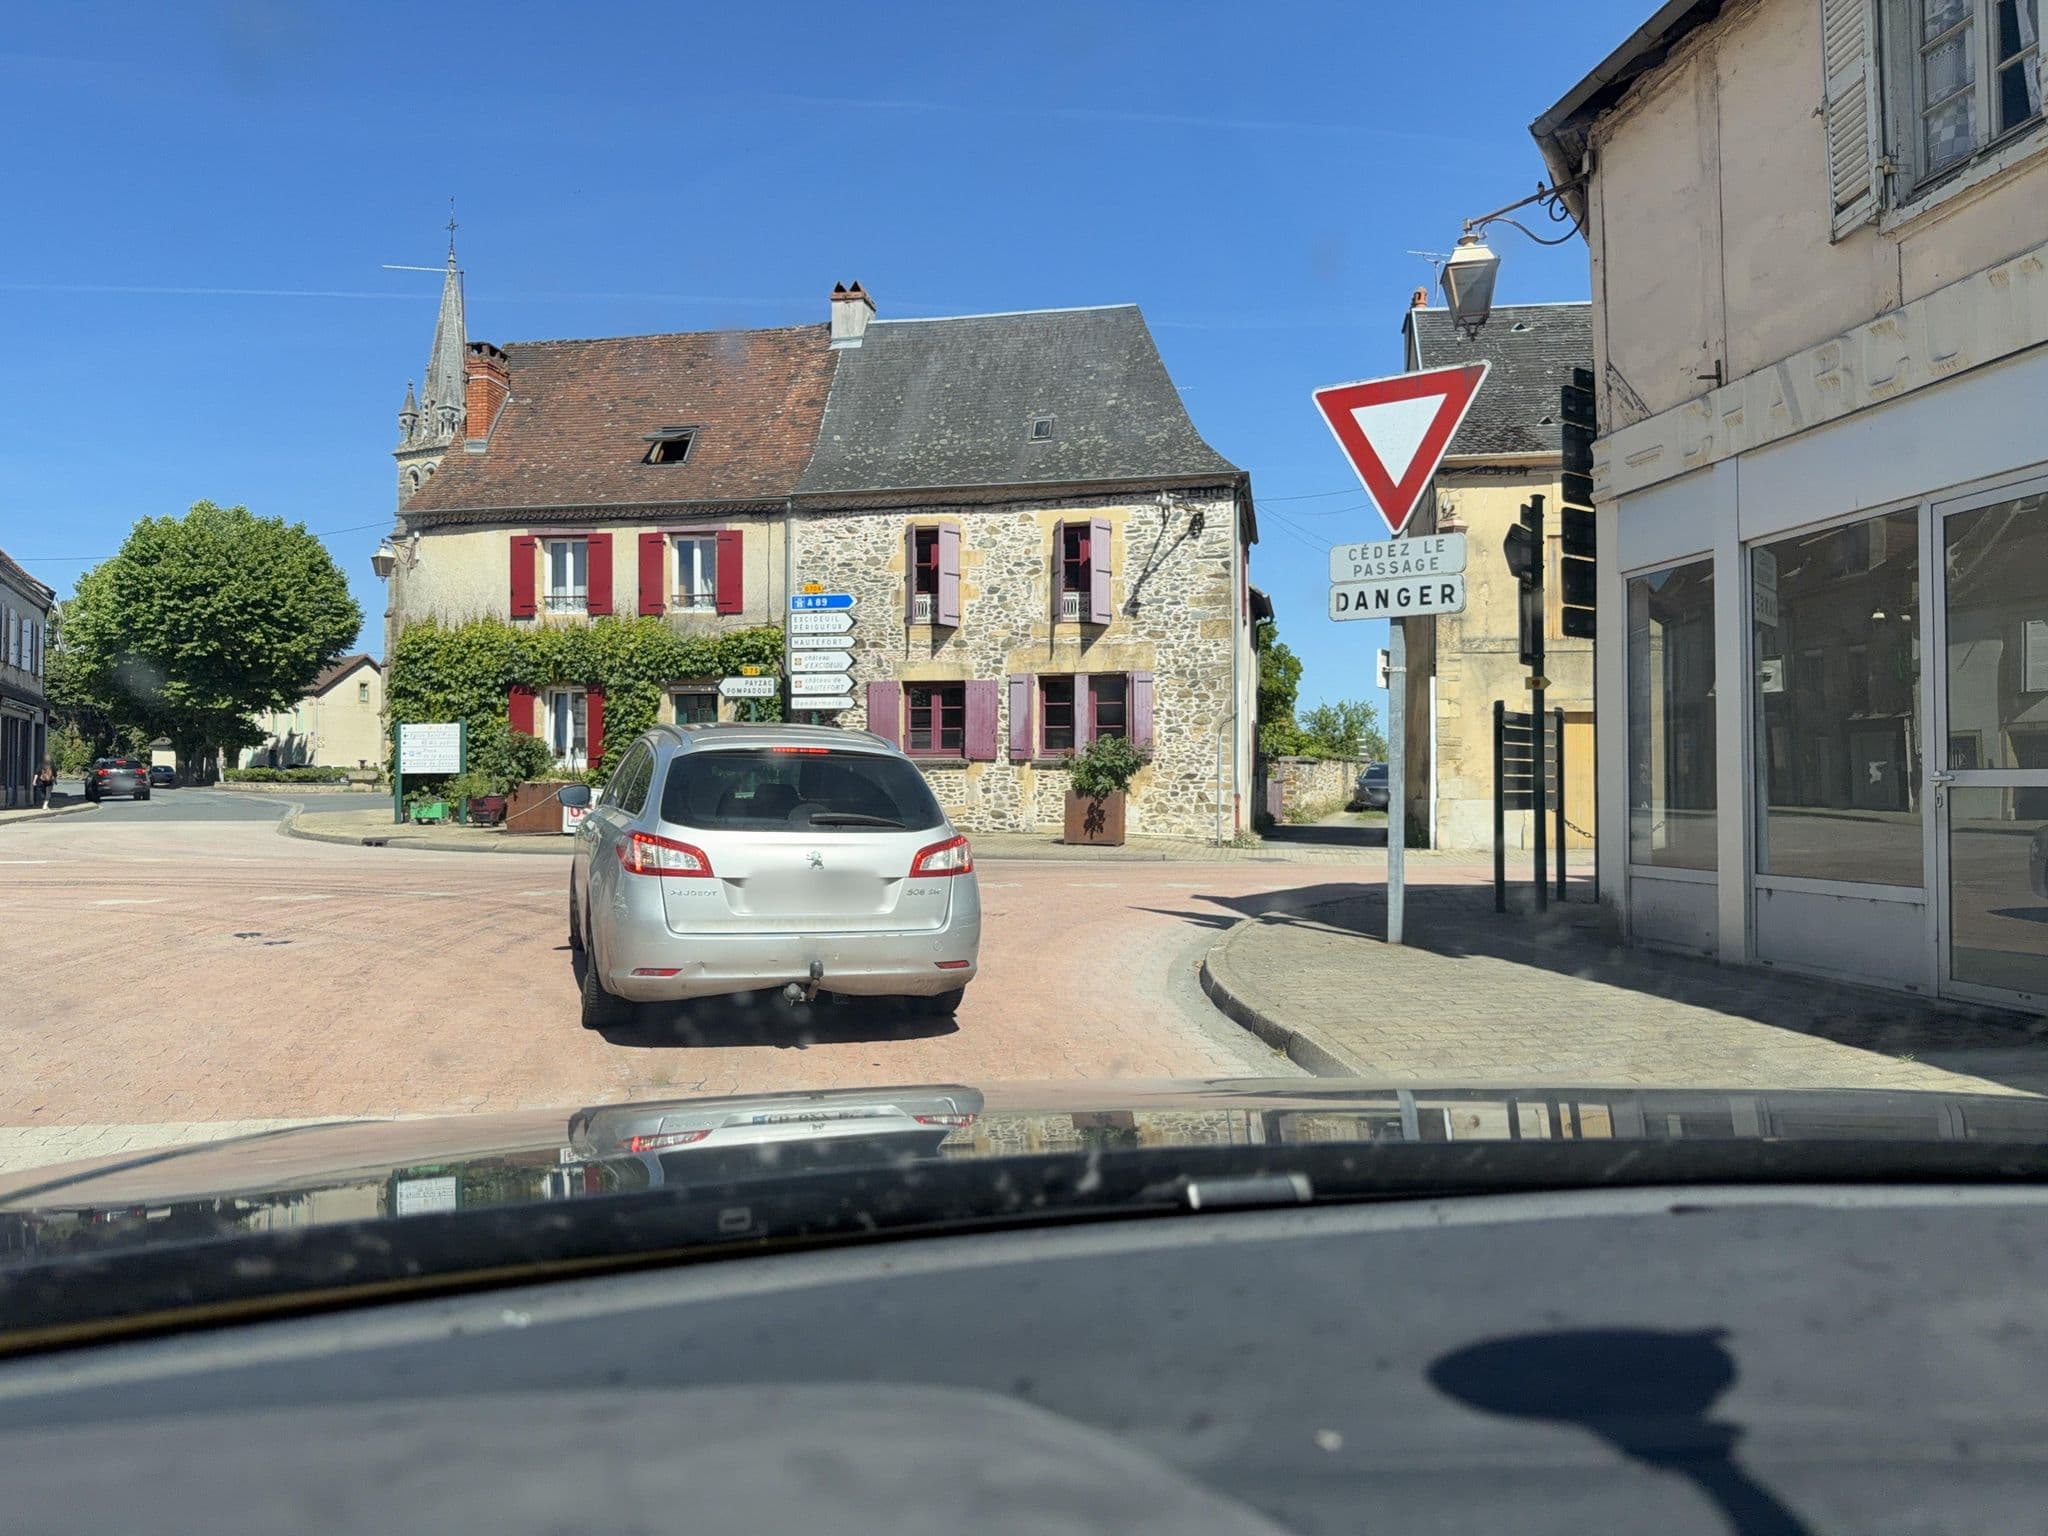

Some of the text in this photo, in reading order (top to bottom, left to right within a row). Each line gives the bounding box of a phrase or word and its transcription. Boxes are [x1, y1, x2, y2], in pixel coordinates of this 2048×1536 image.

[1348, 539, 1446, 561] CÉDEZ LE
[1353, 557, 1439, 577] PASSAGE
[807, 597, 828, 607] A 89
[1335, 583, 1456, 612] DANGER
[793, 638, 842, 646] HAUTEFORT
[745, 679, 772, 687] PAYZAC
[726, 687, 772, 695] POMPADOUR
